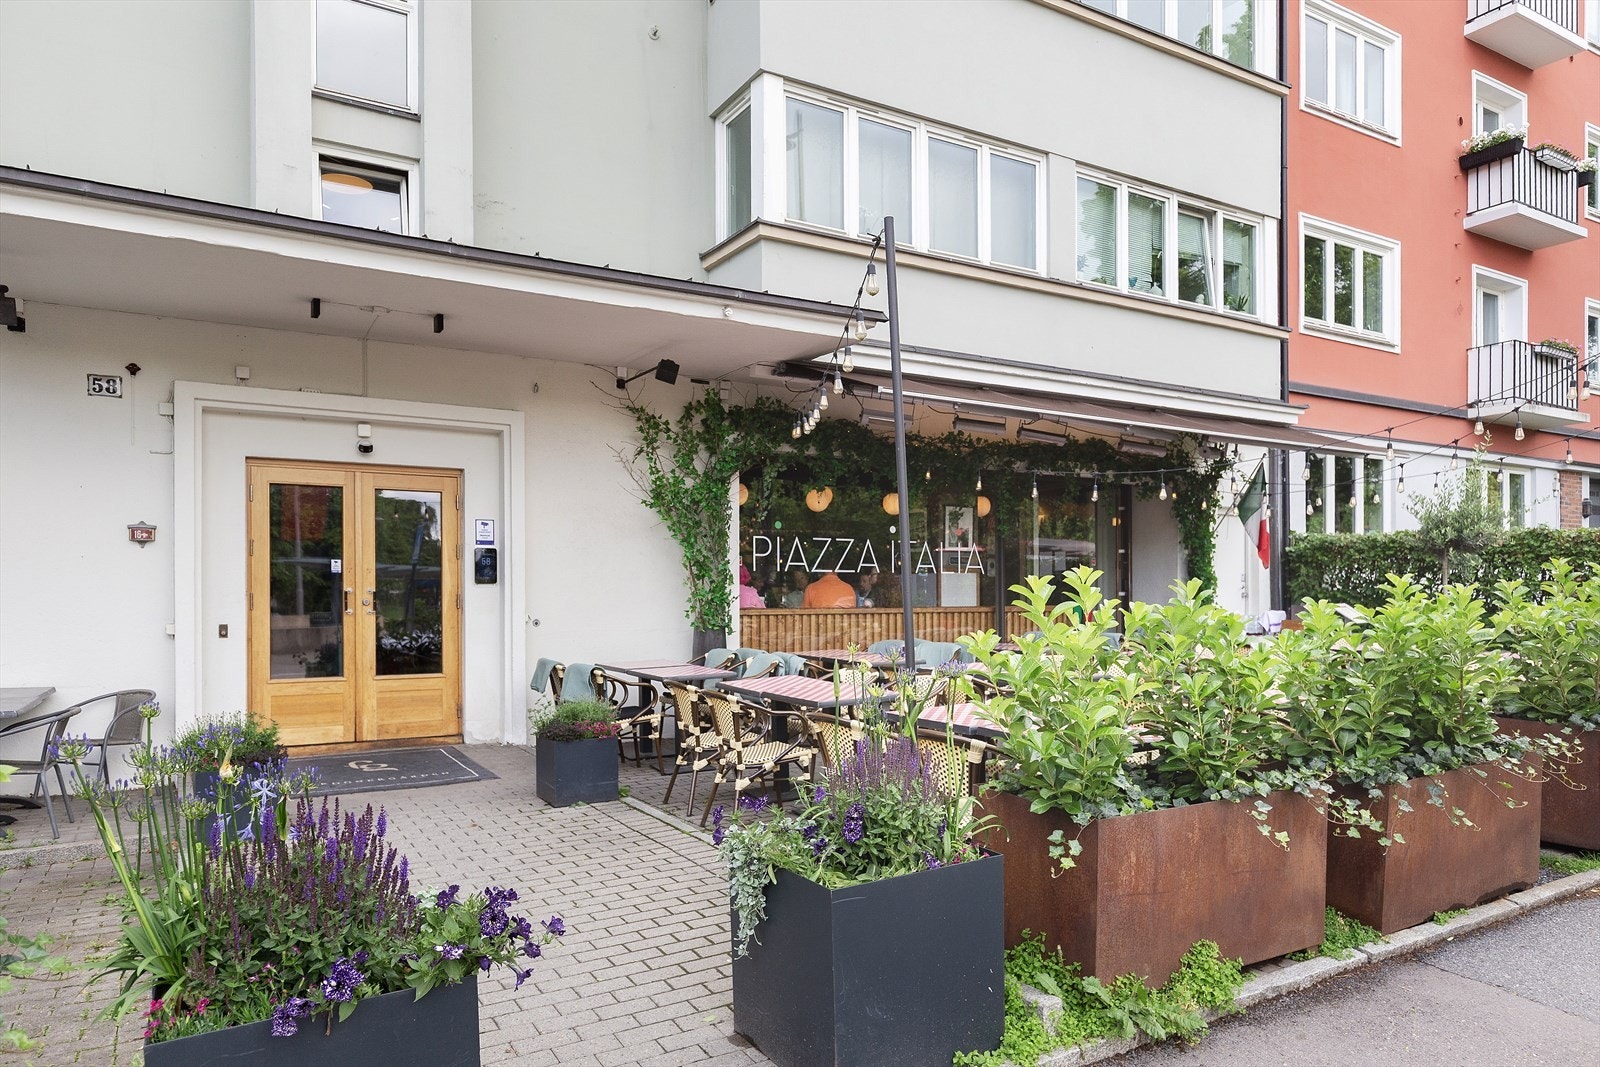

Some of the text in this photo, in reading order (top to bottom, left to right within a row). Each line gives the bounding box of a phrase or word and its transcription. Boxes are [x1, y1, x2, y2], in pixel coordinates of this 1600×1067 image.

[92, 377, 118, 394] 58
[752, 535, 985, 575] PIAZZA IALIA
